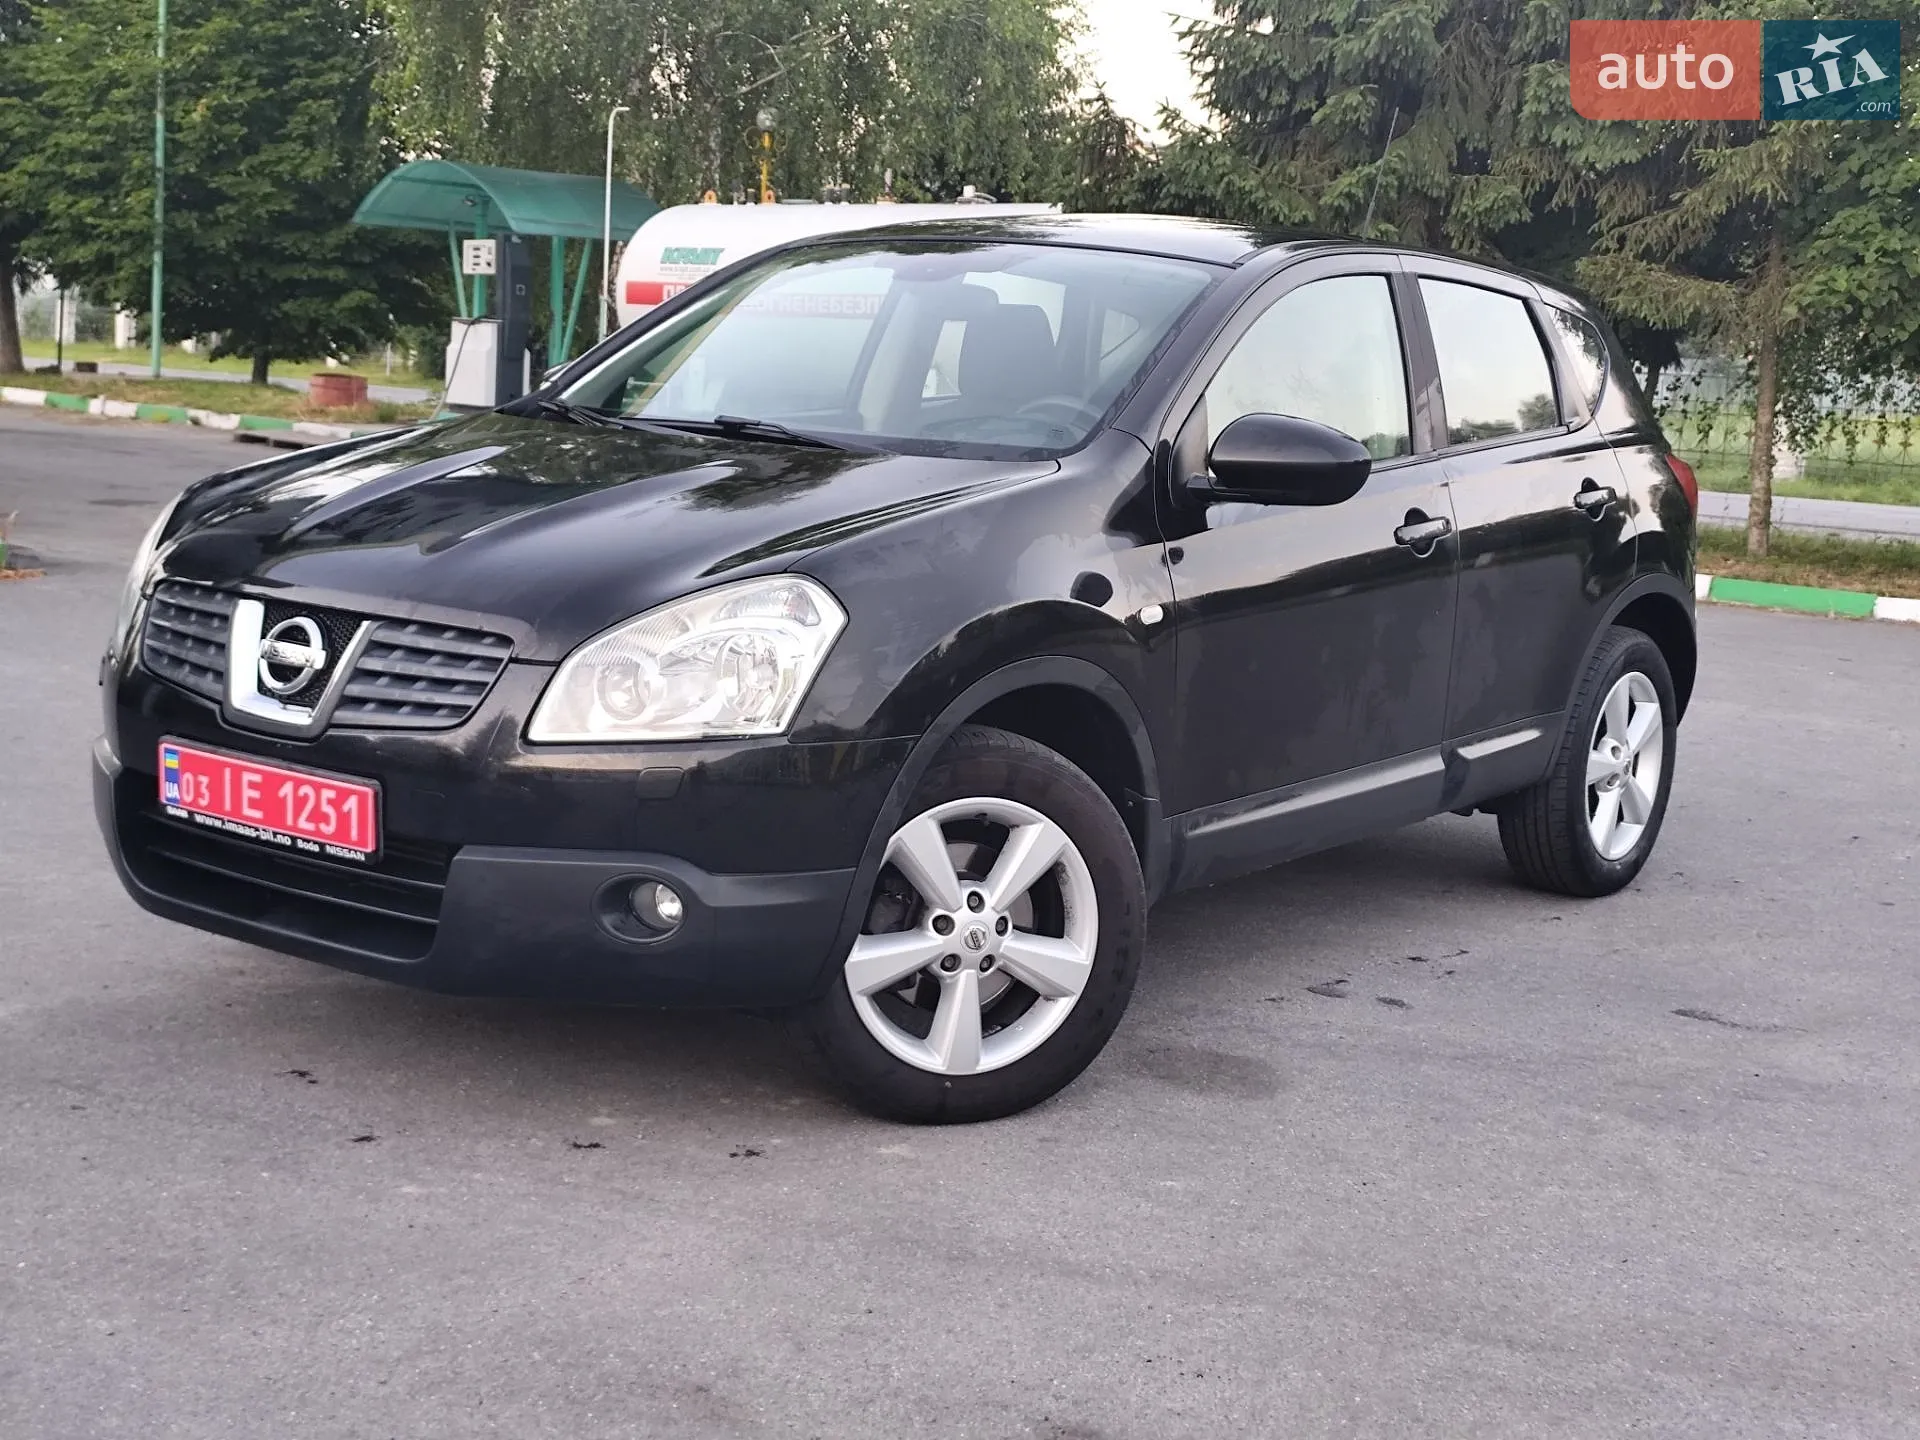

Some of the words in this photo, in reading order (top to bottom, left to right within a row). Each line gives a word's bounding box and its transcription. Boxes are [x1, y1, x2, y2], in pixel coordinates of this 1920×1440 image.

[757, 294, 885, 315] ОГНЕНЕБЕЗП
[166, 781, 180, 799] UA
[182, 773, 210, 807] 03
[278, 780, 359, 842] 1251
[326, 844, 365, 862] NISSAN
